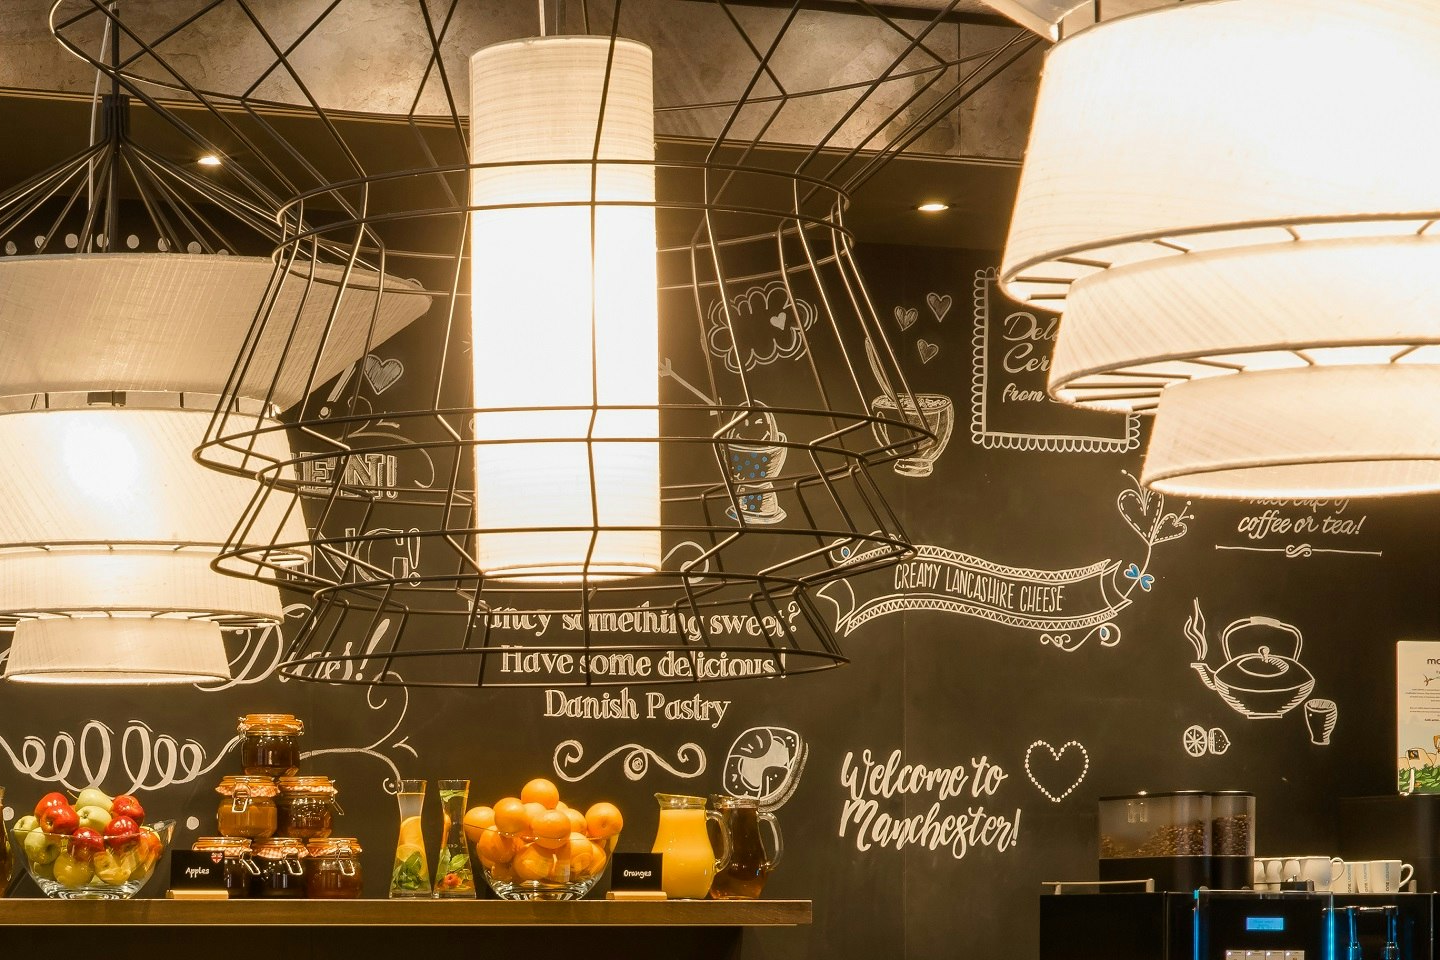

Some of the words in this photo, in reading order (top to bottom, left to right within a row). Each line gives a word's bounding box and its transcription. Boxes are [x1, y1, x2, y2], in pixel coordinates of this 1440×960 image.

[1003, 383, 1045, 403] from
[1237, 510, 1293, 539] coffee
[1294, 516, 1319, 533] or
[1322, 515, 1367, 534] tea!
[894, 562, 942, 590] CREAMY
[1020, 585, 1065, 612] CHEESE
[562, 601, 704, 641] something
[500, 645, 574, 675] Have
[579, 651, 652, 677] some
[544, 687, 639, 720] Danish
[646, 692, 732, 728] Pastry
[840, 749, 969, 801] Welcome
[971, 756, 1008, 797] to
[839, 800, 1021, 859] Manchester!
[185, 867, 210, 878] Apples
[623, 869, 652, 879] Oranges
